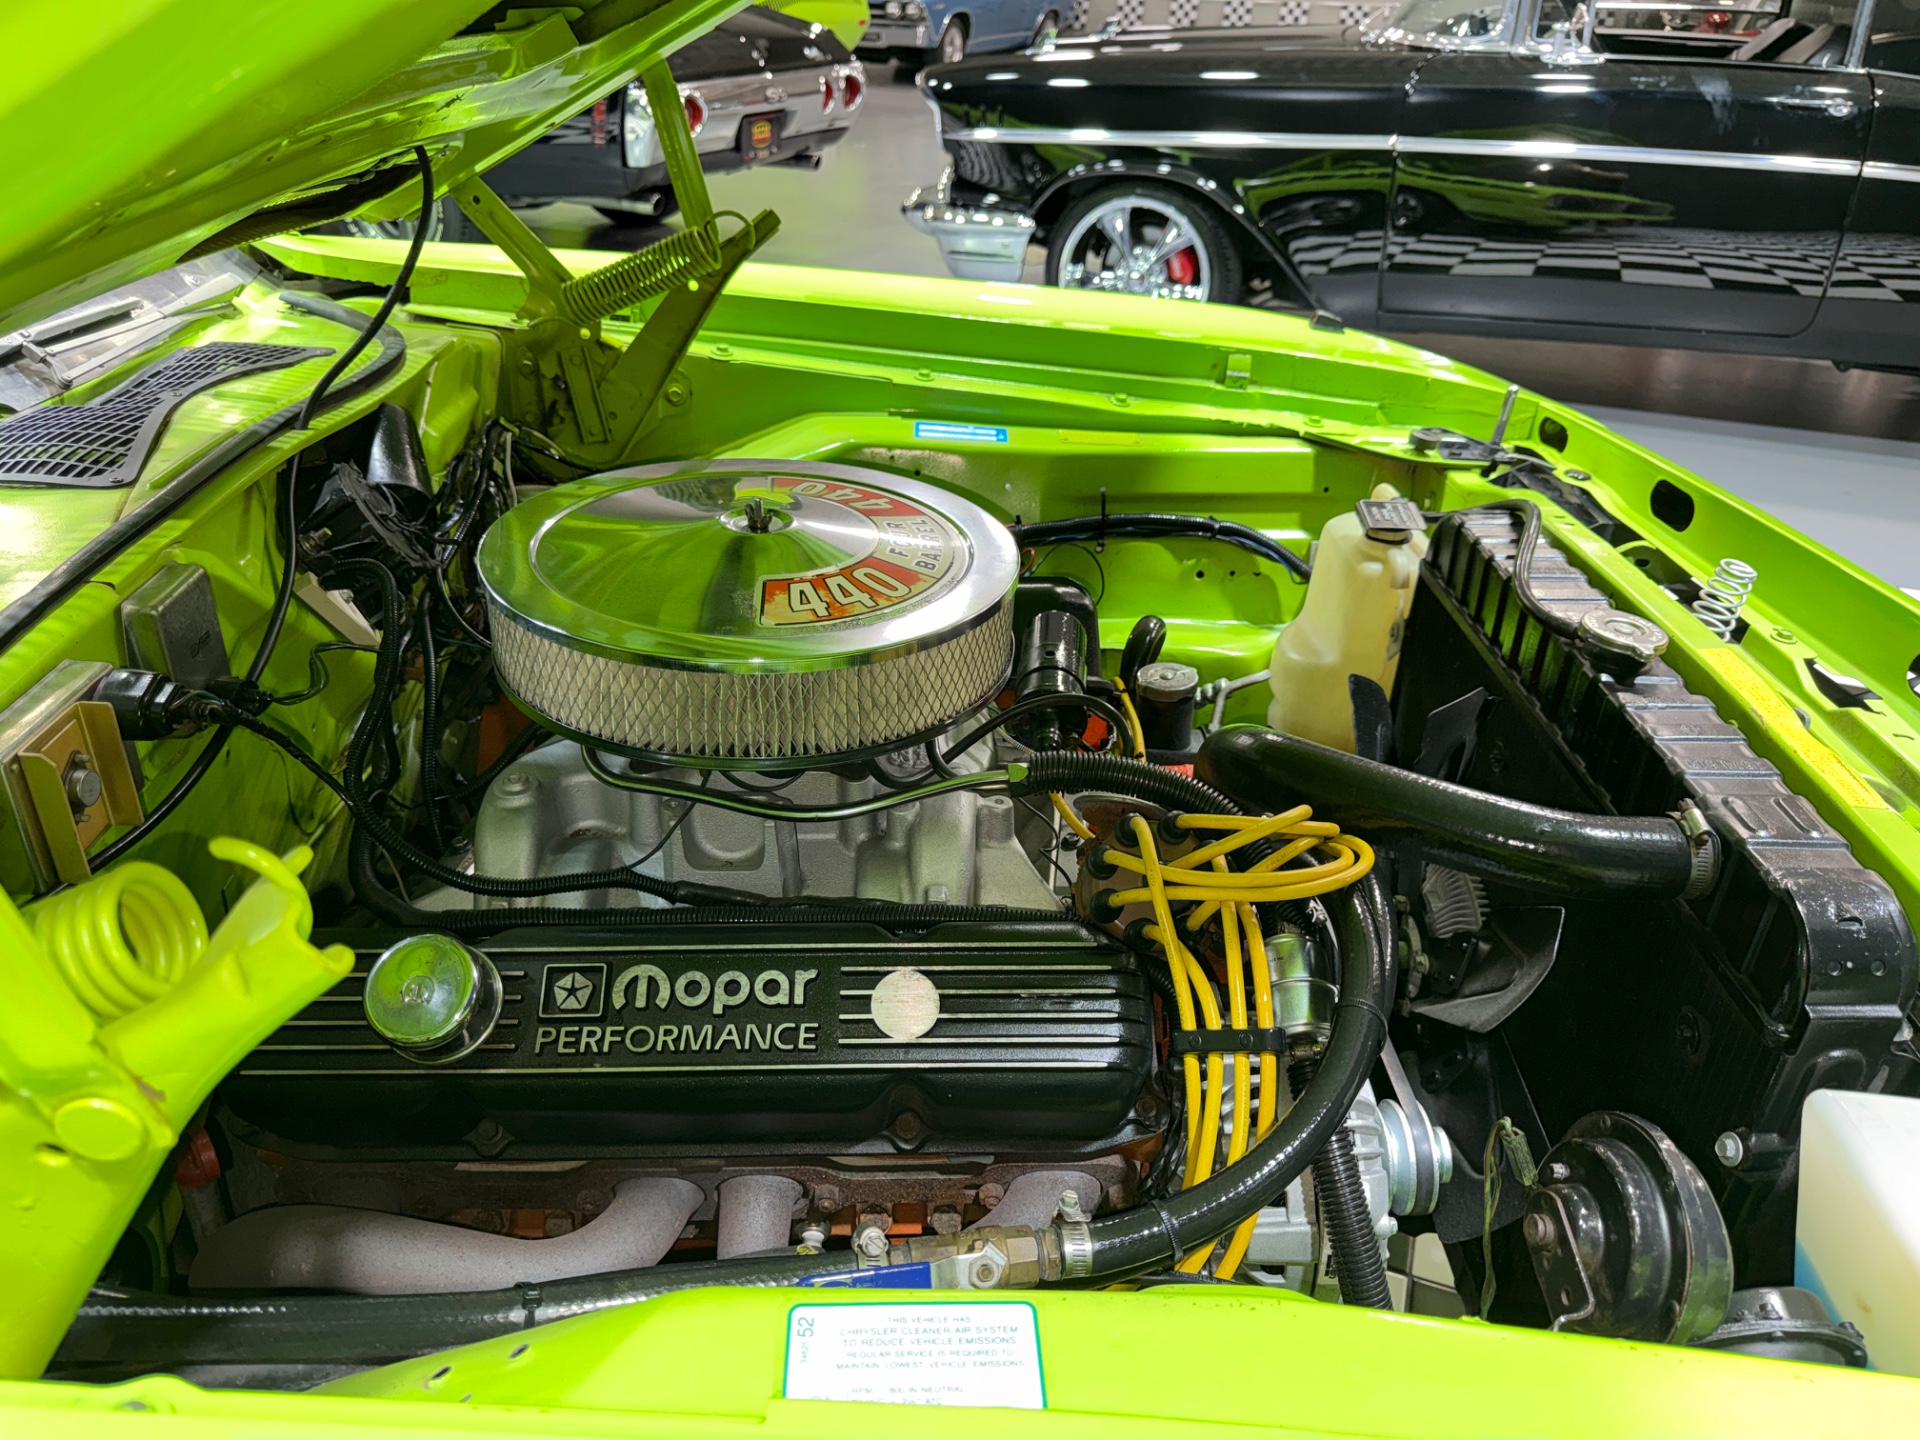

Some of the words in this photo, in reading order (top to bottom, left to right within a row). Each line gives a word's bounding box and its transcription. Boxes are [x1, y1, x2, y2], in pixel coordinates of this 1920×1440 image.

[789, 481, 897, 511] 440
[886, 521, 911, 558] FOUR
[914, 519, 943, 571] BARREL
[787, 566, 912, 618] 440
[1266, 844, 1299, 870] PREMIUM
[534, 1022, 820, 1054] PERFORMANCE
[796, 1316, 815, 1338] 52
[839, 1327, 897, 1336] CHRYSLER
[901, 1326, 950, 1335] CLEANER
[954, 1326, 971, 1334] AIR
[976, 1325, 1018, 1334] SYSTEM
[888, 1316, 908, 1324] THIS
[911, 1316, 948, 1324] VEHICLE
[952, 1315, 971, 1323] HAS
[843, 1339, 857, 1347] TO
[862, 1338, 904, 1347] REDUCE
[909, 1337, 954, 1346] VEHICLE
[958, 1336, 1016, 1345] EMISSIONS
[835, 1362, 880, 1370] MAINTAIN
[886, 1361, 923, 1369] LOWEST
[929, 1361, 967, 1369] VEHICLE
[974, 1360, 1025, 1368] EMISSIONS
[846, 1350, 891, 1359] REGULAR
[895, 1350, 934, 1358] SERVICE
[938, 1349, 946, 1357] IS
[949, 1349, 998, 1357] REQUIRED
[921, 1386, 964, 1394] NEUTRAL
